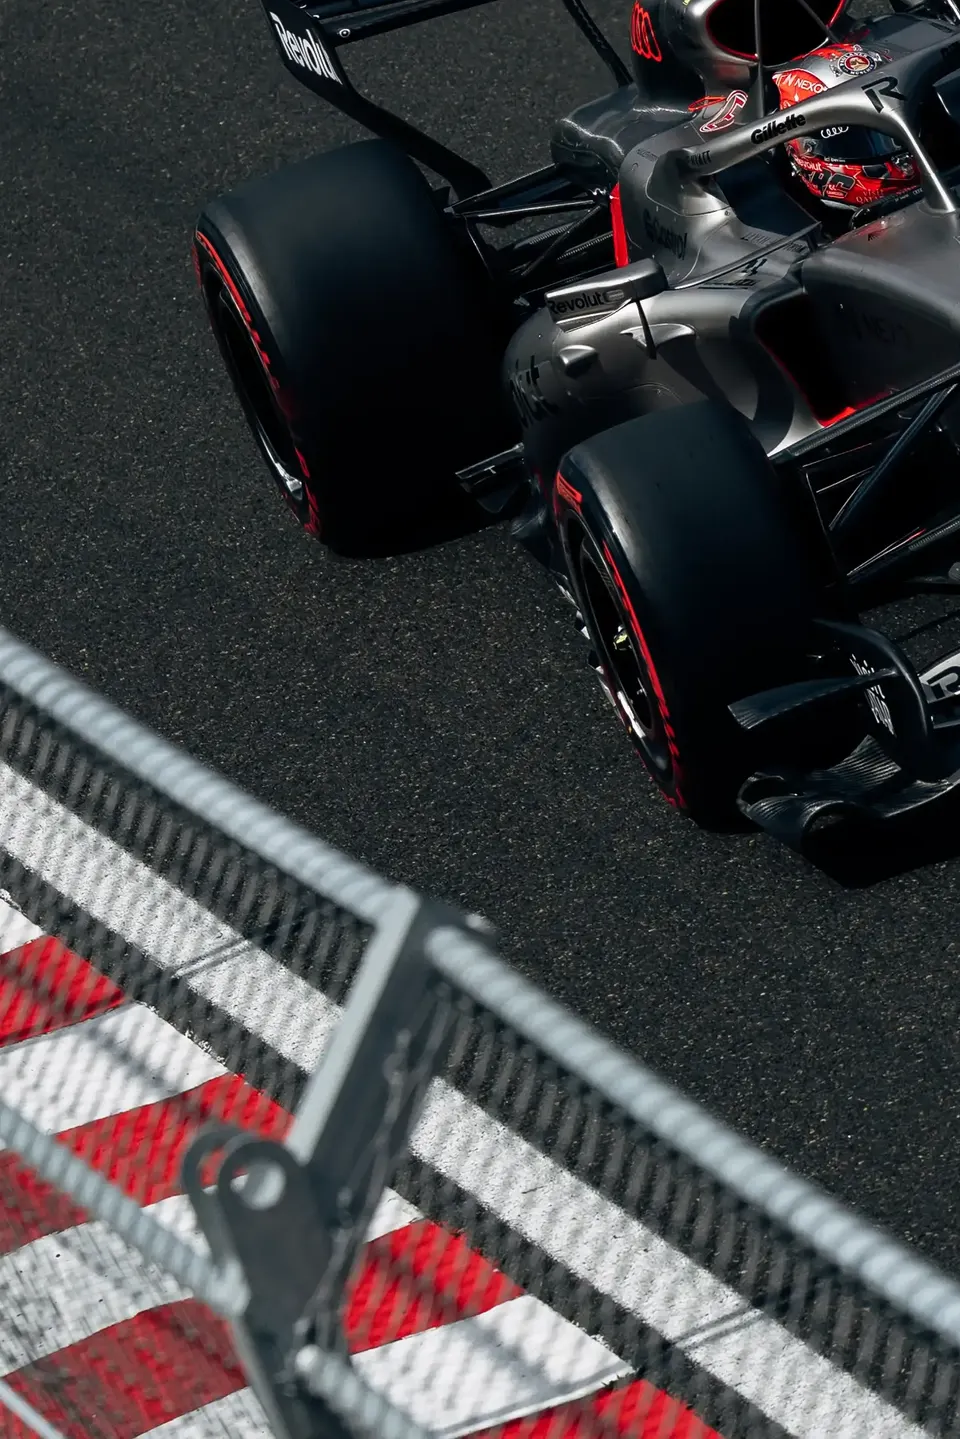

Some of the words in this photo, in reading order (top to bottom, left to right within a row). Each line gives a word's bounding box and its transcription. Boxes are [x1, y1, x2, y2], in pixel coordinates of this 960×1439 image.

[861, 76, 908, 113] R
[751, 114, 806, 144] Gillette
[547, 292, 605, 314] Revolut
